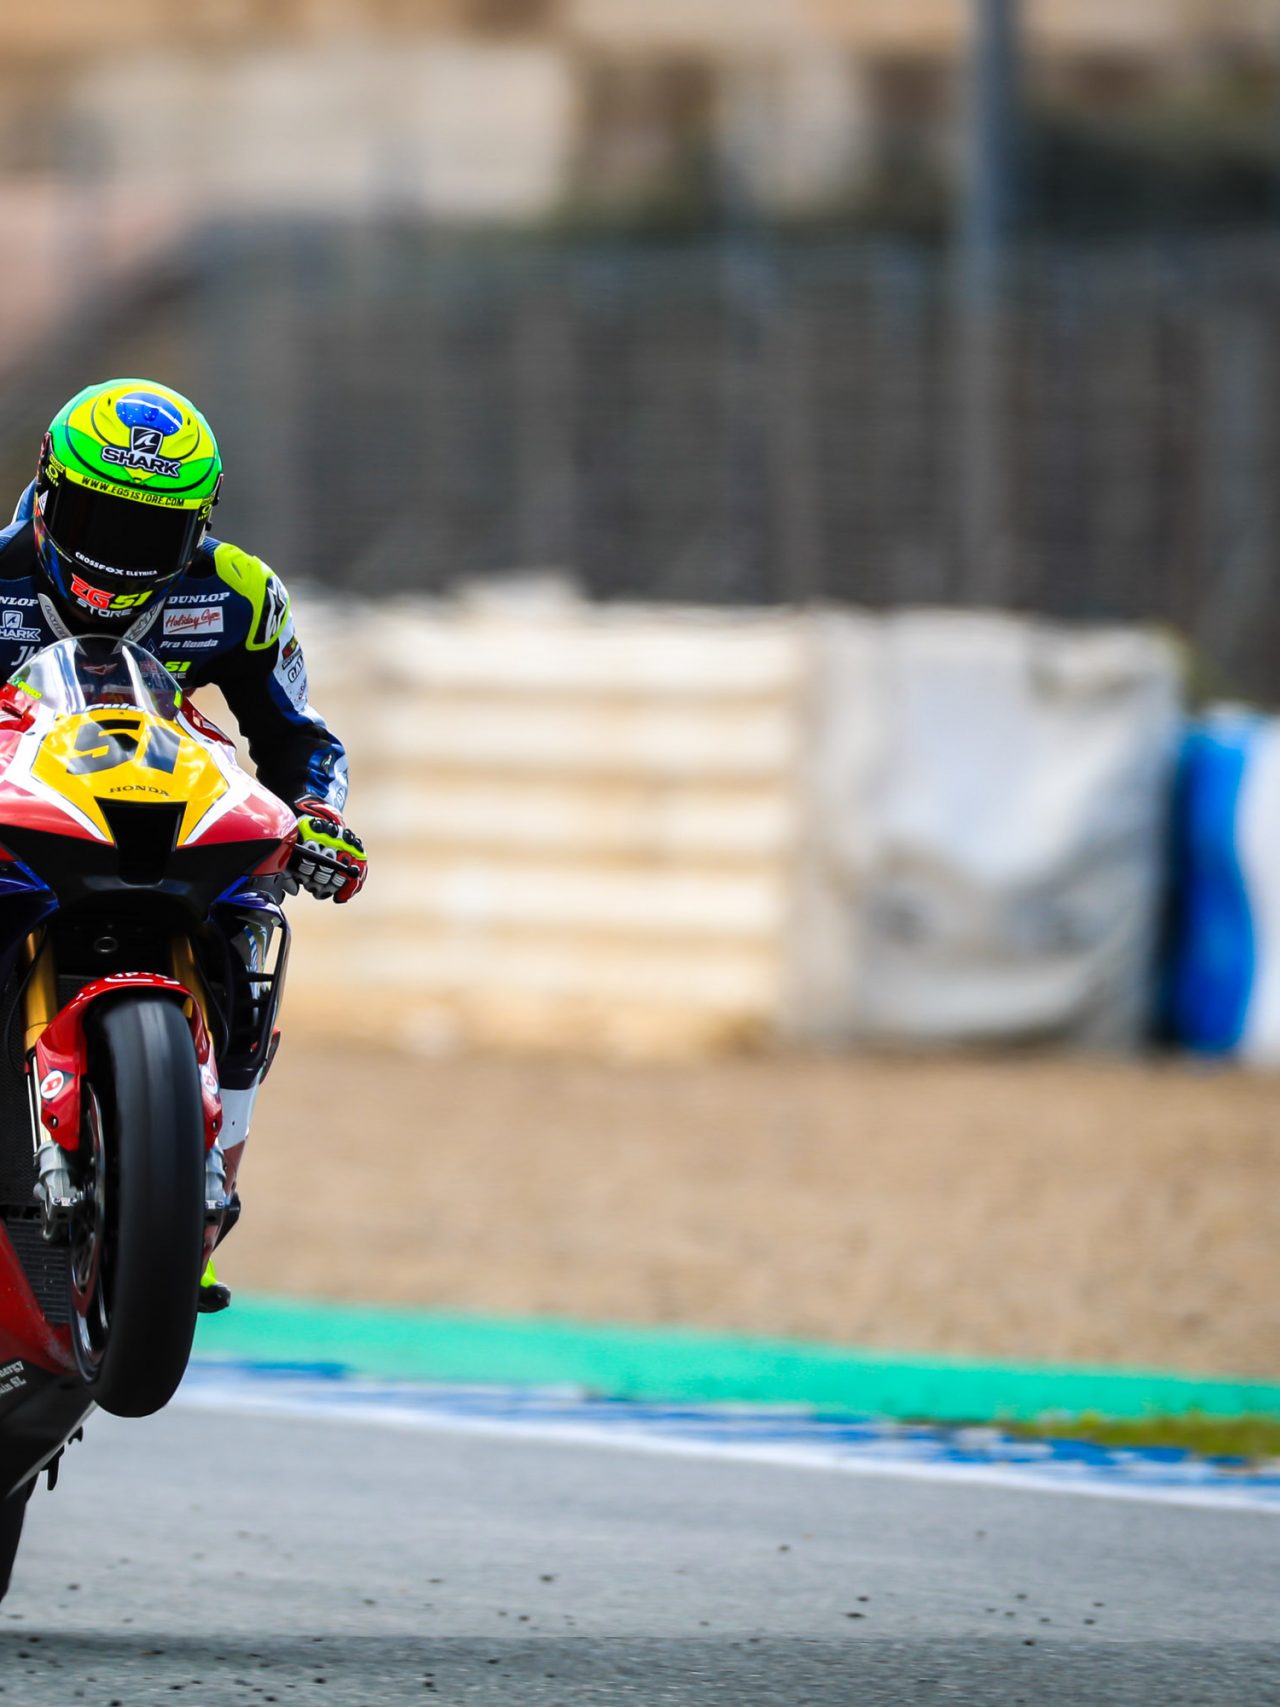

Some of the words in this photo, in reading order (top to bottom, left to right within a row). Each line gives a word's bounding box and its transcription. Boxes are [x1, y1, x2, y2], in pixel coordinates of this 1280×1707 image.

[102, 447, 181, 477] SHARK
[81, 476, 185, 507] WWW.EG51STORE.COM
[75, 552, 124, 576] CROSSFOX
[76, 597, 133, 617] STORE
[167, 592, 230, 604] DUNLOP
[160, 640, 181, 648] Pro
[182, 638, 219, 648] Honda
[66, 719, 181, 776] 51
[109, 785, 170, 797] HONDA
